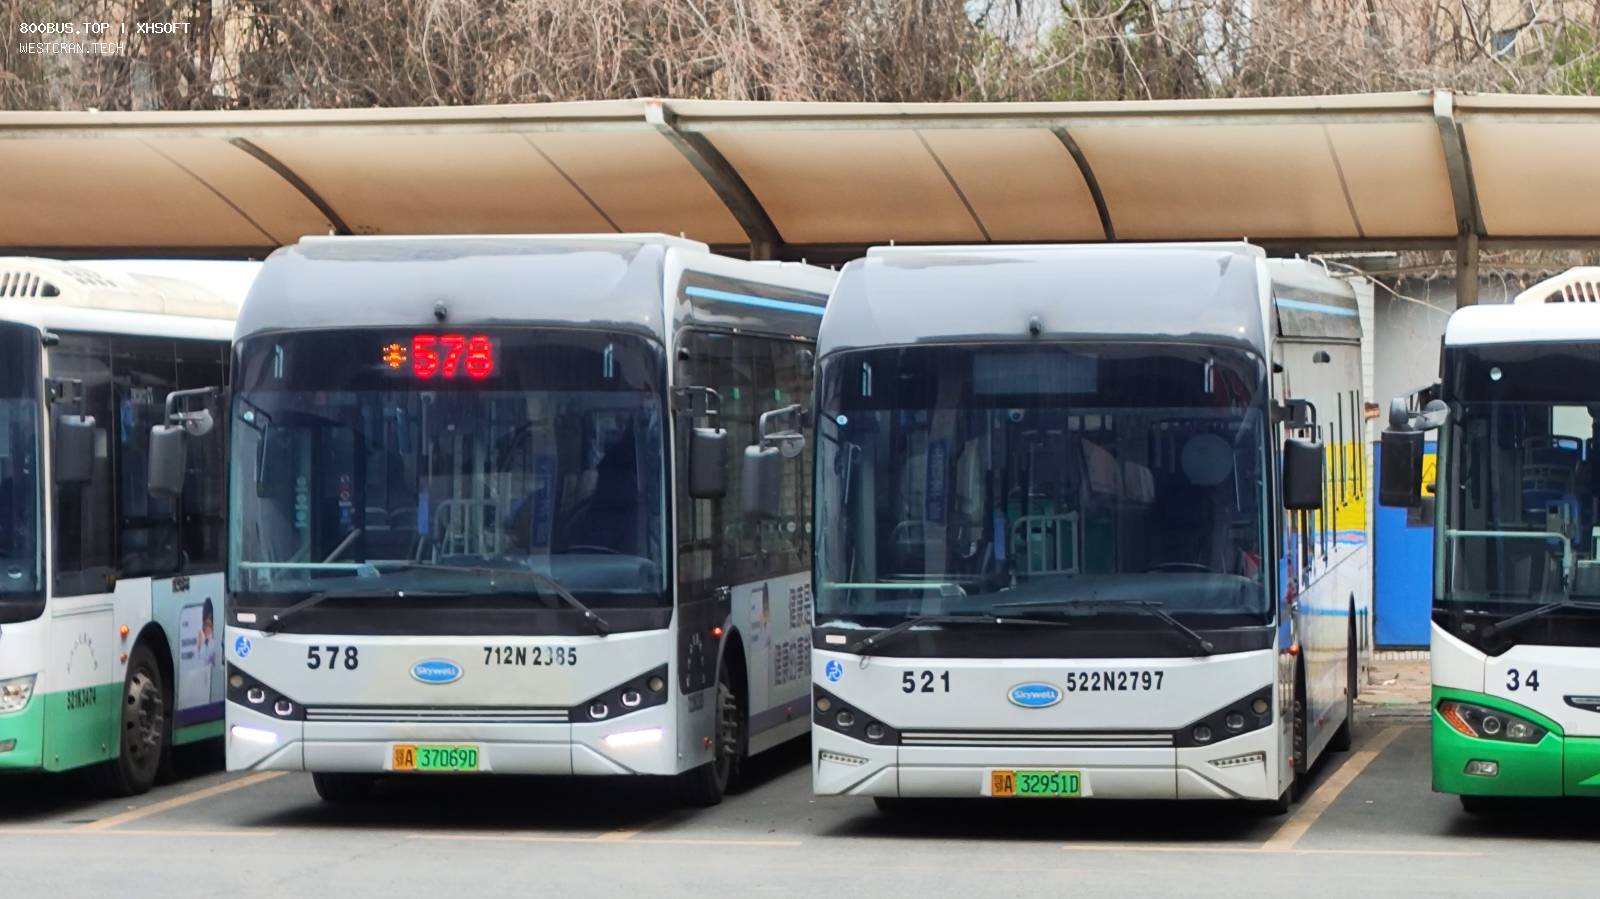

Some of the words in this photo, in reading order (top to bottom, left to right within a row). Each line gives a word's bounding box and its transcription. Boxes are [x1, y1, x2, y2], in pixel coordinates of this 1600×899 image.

[412, 335, 494, 379] 578
[306, 645, 359, 670] 578
[902, 670, 950, 693] 521
[1067, 671, 1164, 692] 522N2797
[1506, 668, 1540, 692] 34
